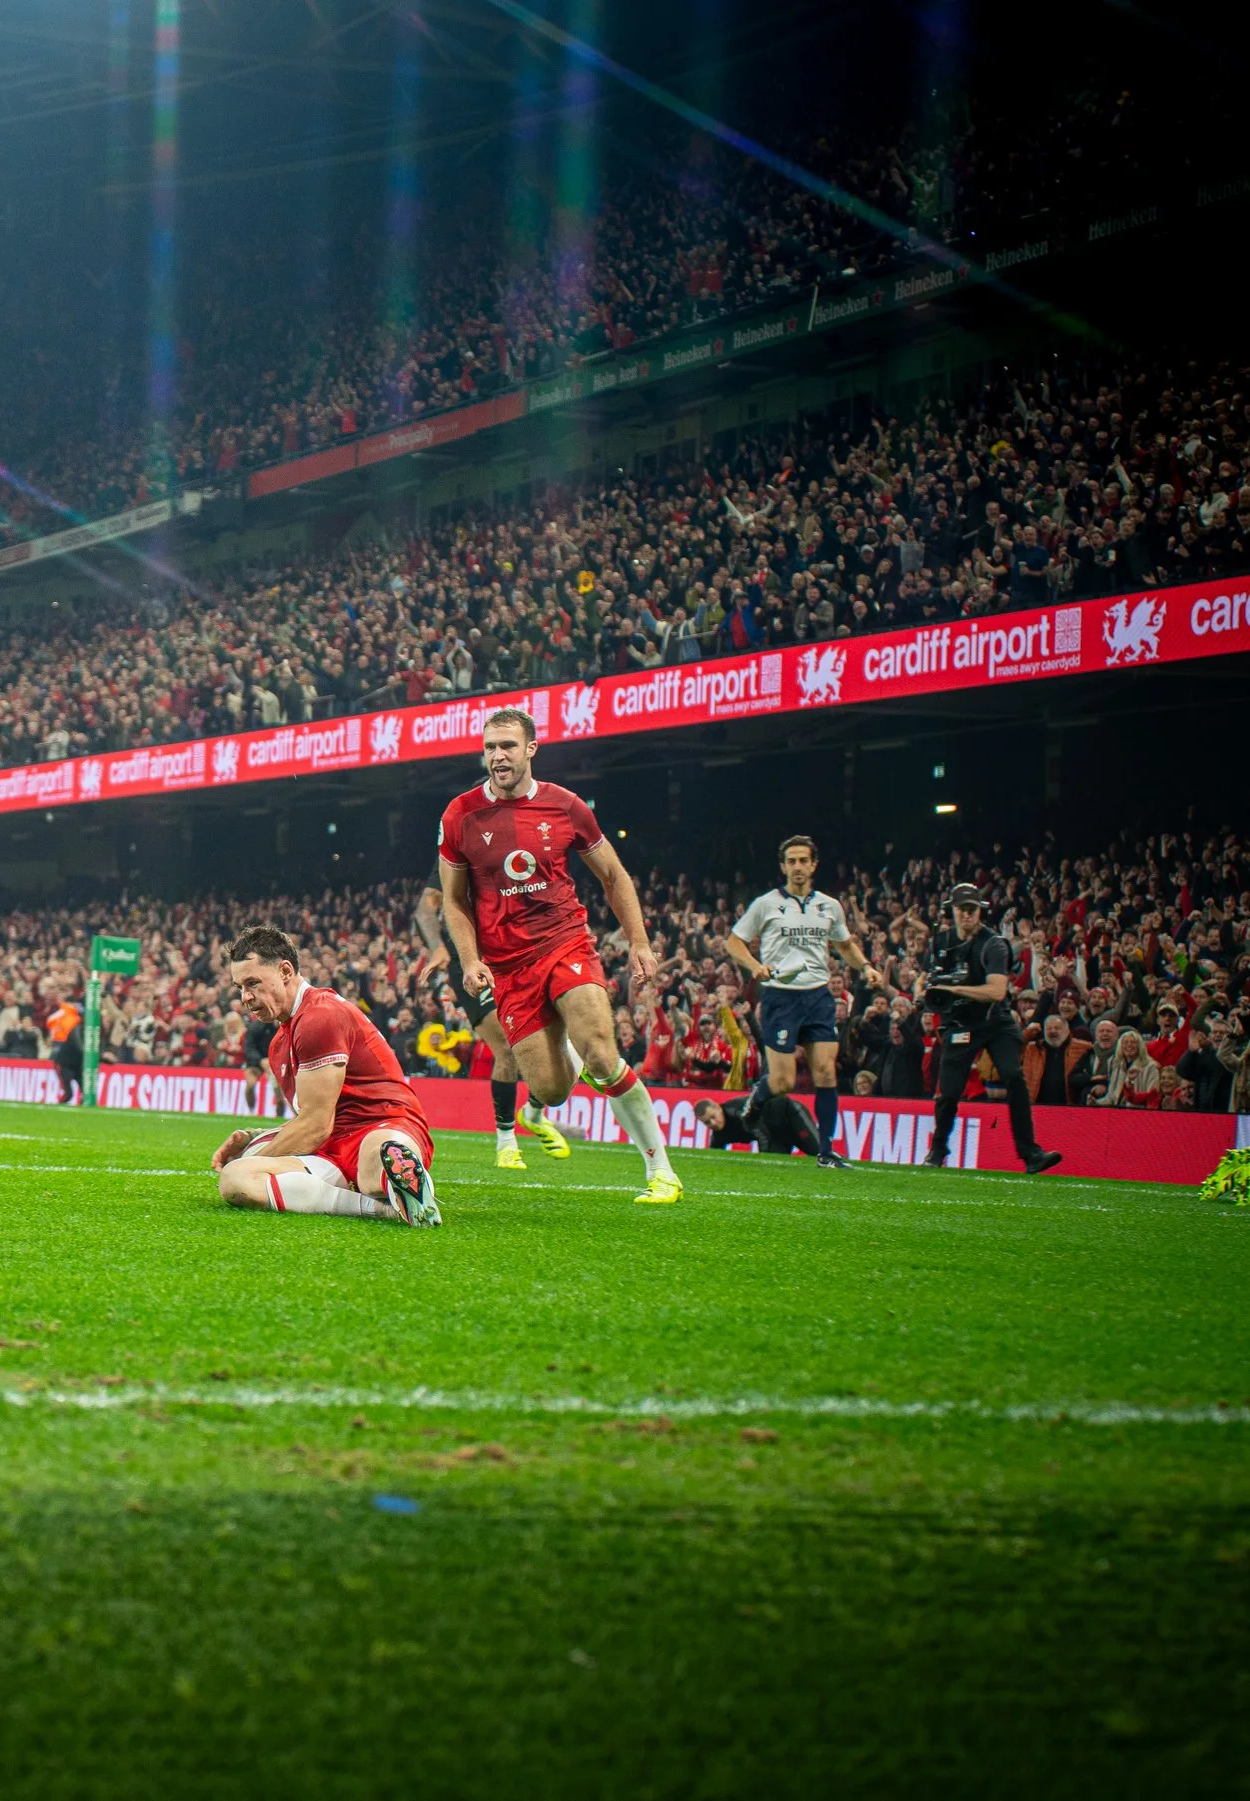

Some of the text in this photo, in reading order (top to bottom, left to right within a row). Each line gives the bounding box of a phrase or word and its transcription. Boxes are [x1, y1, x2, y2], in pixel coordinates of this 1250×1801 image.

[984, 240, 1049, 272] Heineken
[894, 270, 954, 301] Heineken
[814, 295, 869, 326] Heineken
[864, 615, 1050, 681] cardiff airport
[613, 660, 758, 717] cardiff airport
[412, 702, 469, 744] cardiff
[109, 746, 192, 787] cardiff airport
[248, 724, 345, 768] cardiff airport
[500, 881, 547, 897] vodafone
[781, 926, 827, 938] Emirates
[106, 1072, 136, 1108] OF
[137, 1074, 210, 1113] SOUTH
